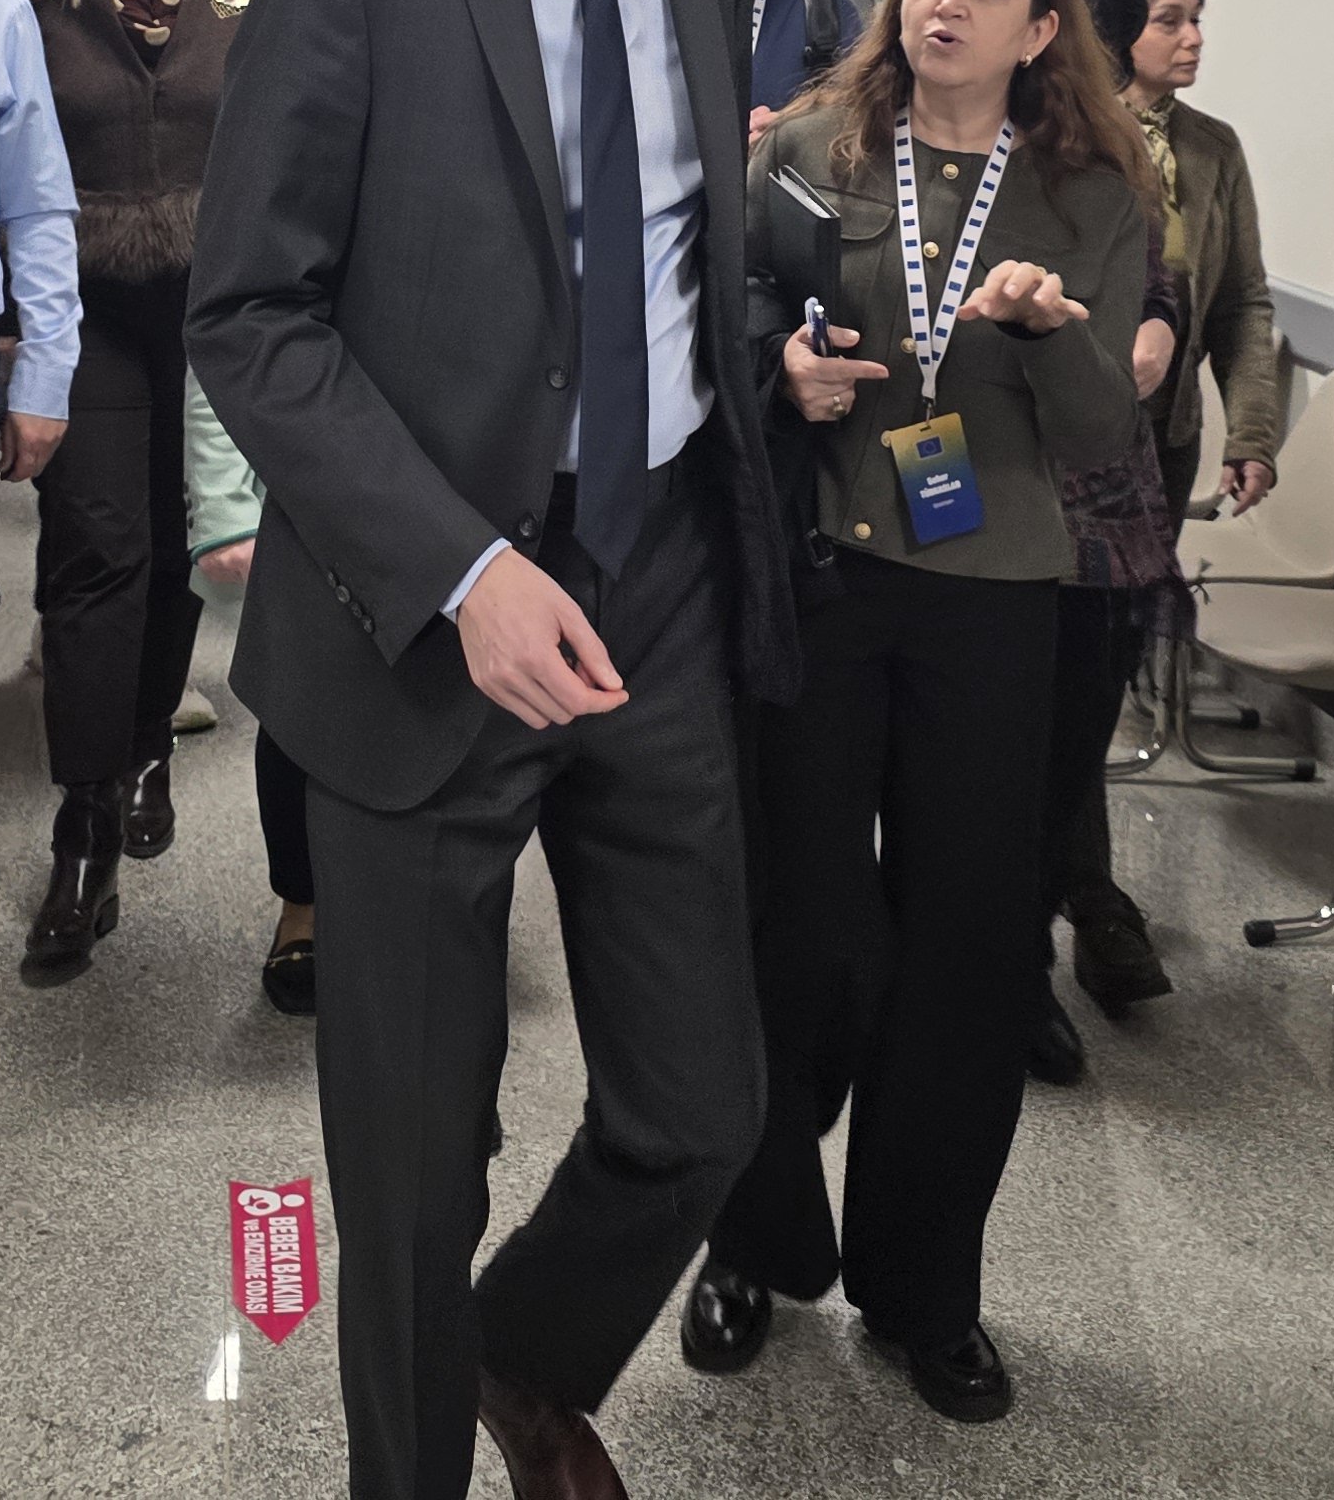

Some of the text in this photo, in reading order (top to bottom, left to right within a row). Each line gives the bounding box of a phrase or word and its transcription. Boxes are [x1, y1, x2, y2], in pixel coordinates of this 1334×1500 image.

[243, 1218, 260, 1231] ve
[268, 1216, 304, 1313] BEBEK BAKIM
[245, 1281, 268, 1314] ODASI
